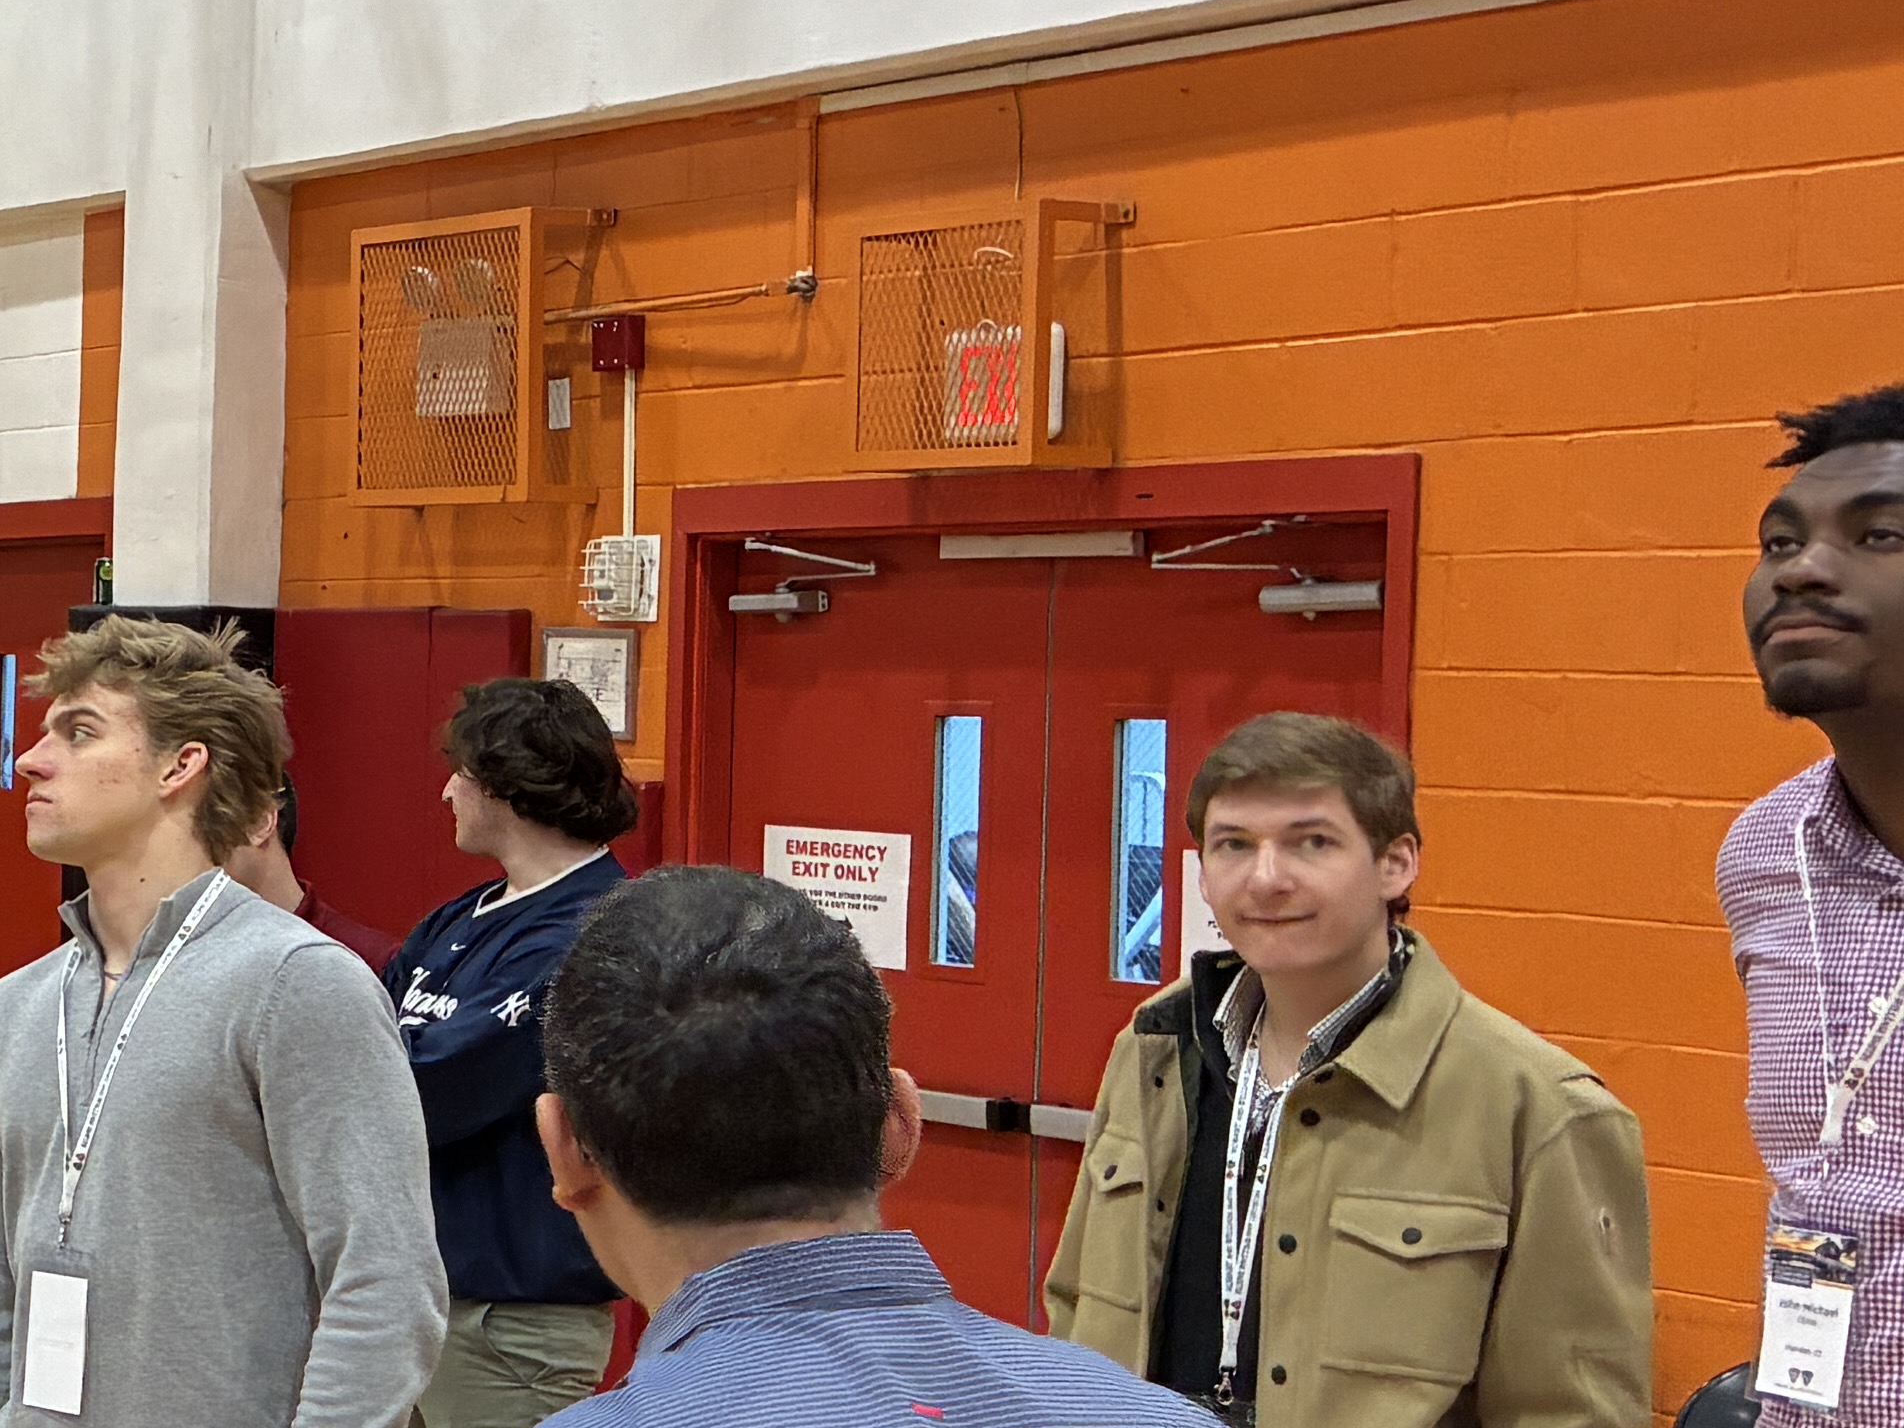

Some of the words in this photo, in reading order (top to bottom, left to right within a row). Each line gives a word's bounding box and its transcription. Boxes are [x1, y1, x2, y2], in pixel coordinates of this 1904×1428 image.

[785, 839, 888, 863] EMERGENCY
[791, 860, 830, 879] EXIT
[833, 864, 879, 883] ONLY
